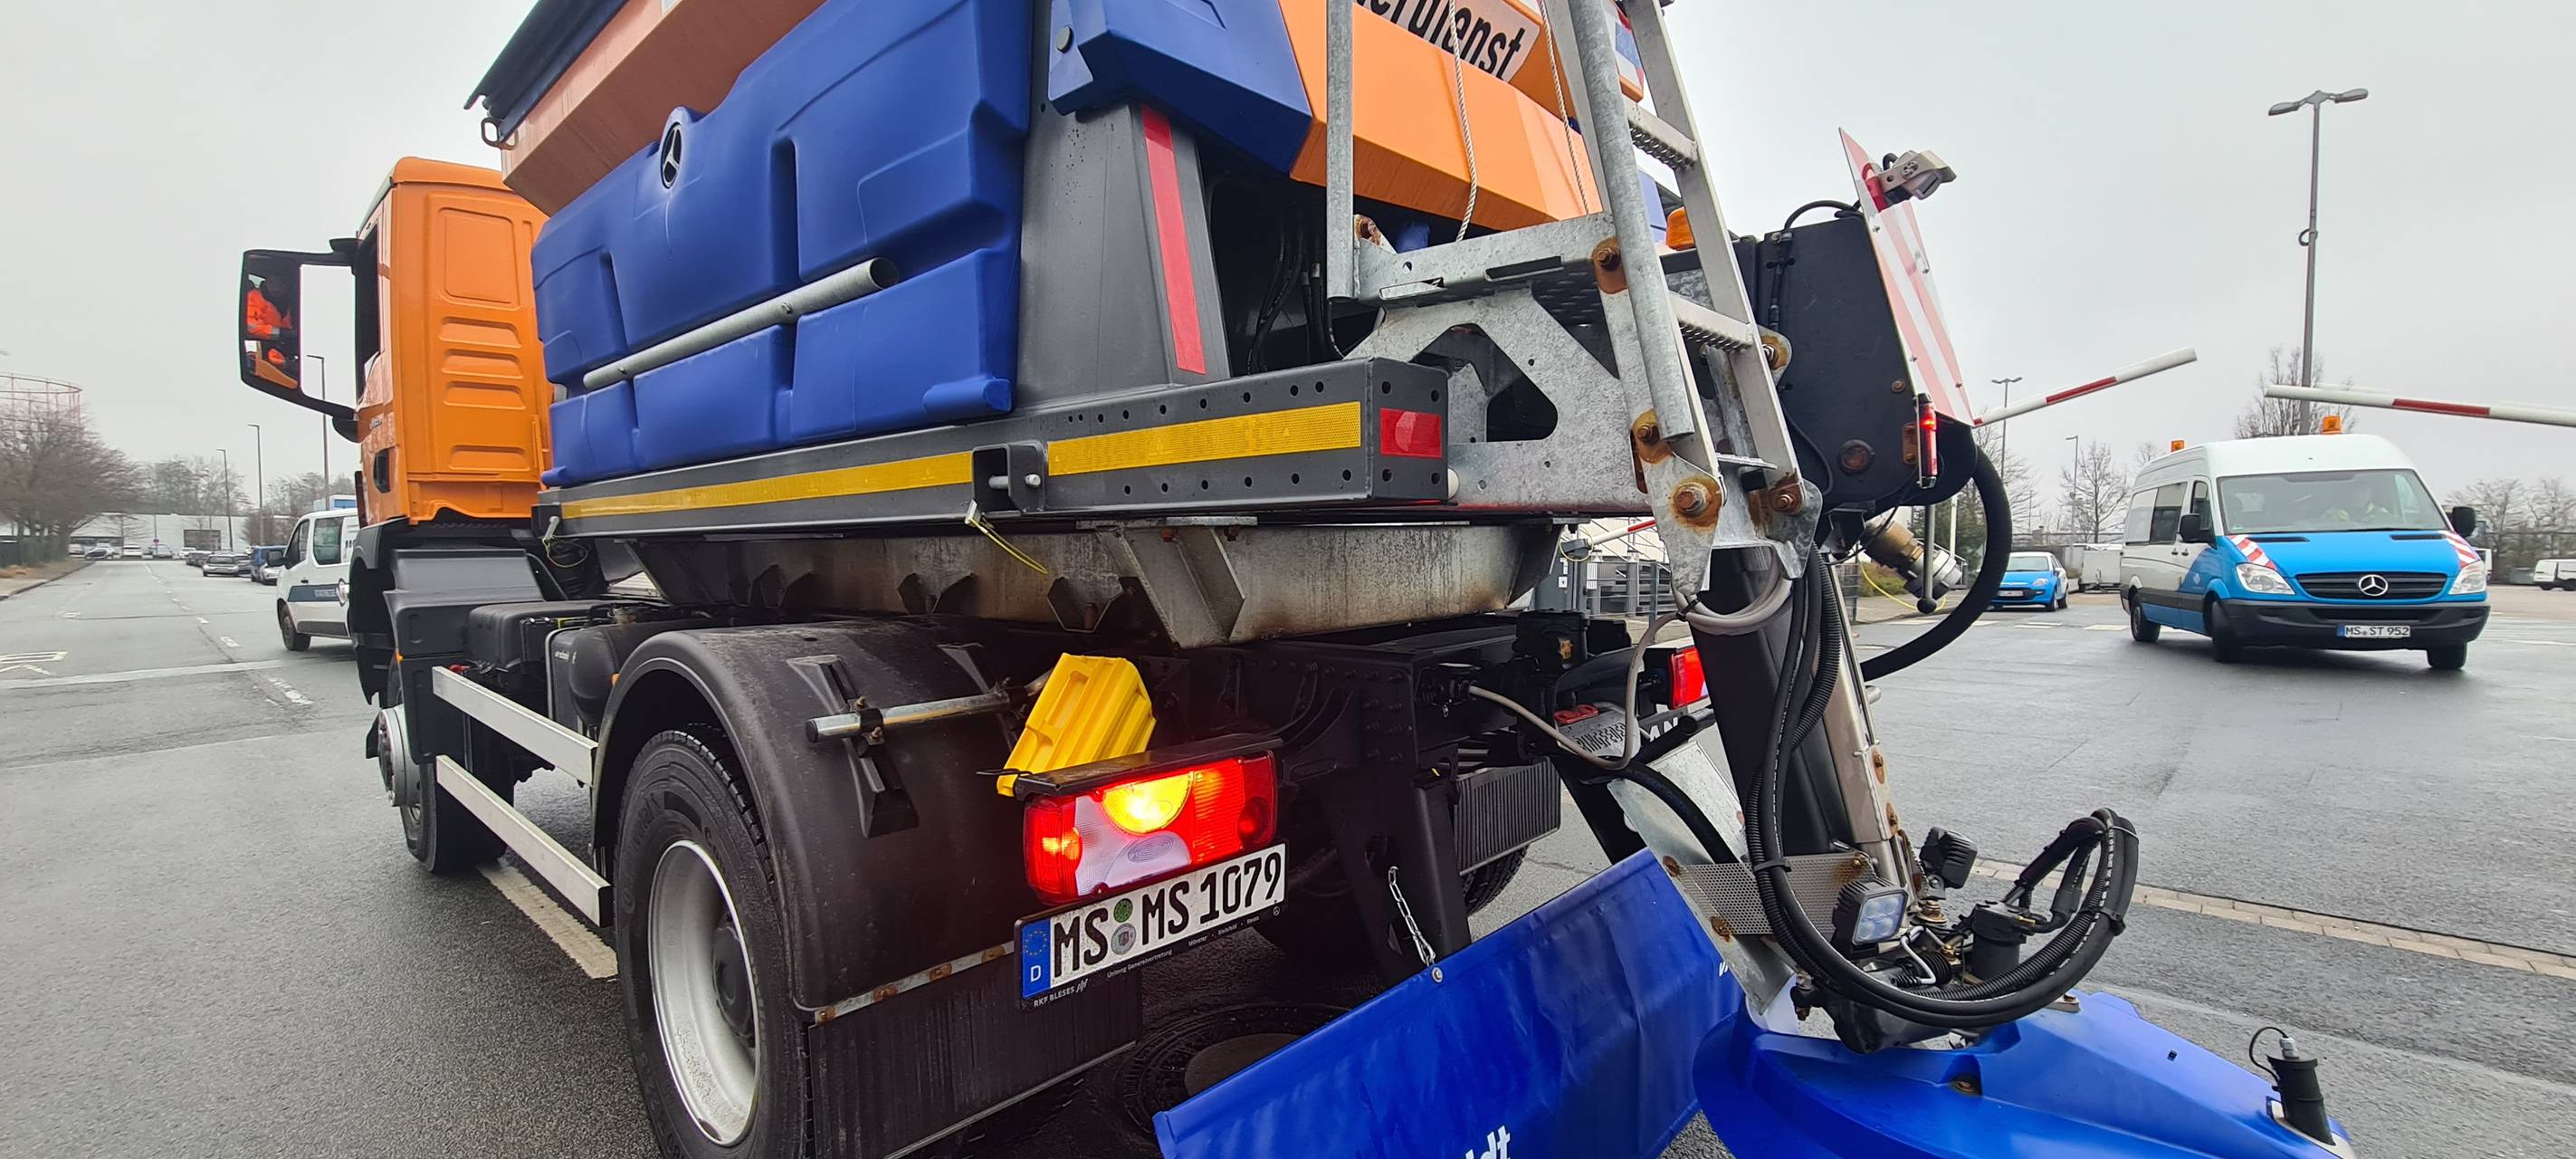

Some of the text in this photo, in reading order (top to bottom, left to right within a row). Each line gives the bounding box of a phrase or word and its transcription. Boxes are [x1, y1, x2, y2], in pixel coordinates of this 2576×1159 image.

[2345, 627, 2409, 636] MS ST 952
[1054, 852, 1283, 978] MS MS 1079
[1030, 964, 1042, 983] D
[1033, 986, 1076, 1008] RKF BLESES
[1465, 1125, 1511, 1159] dt
